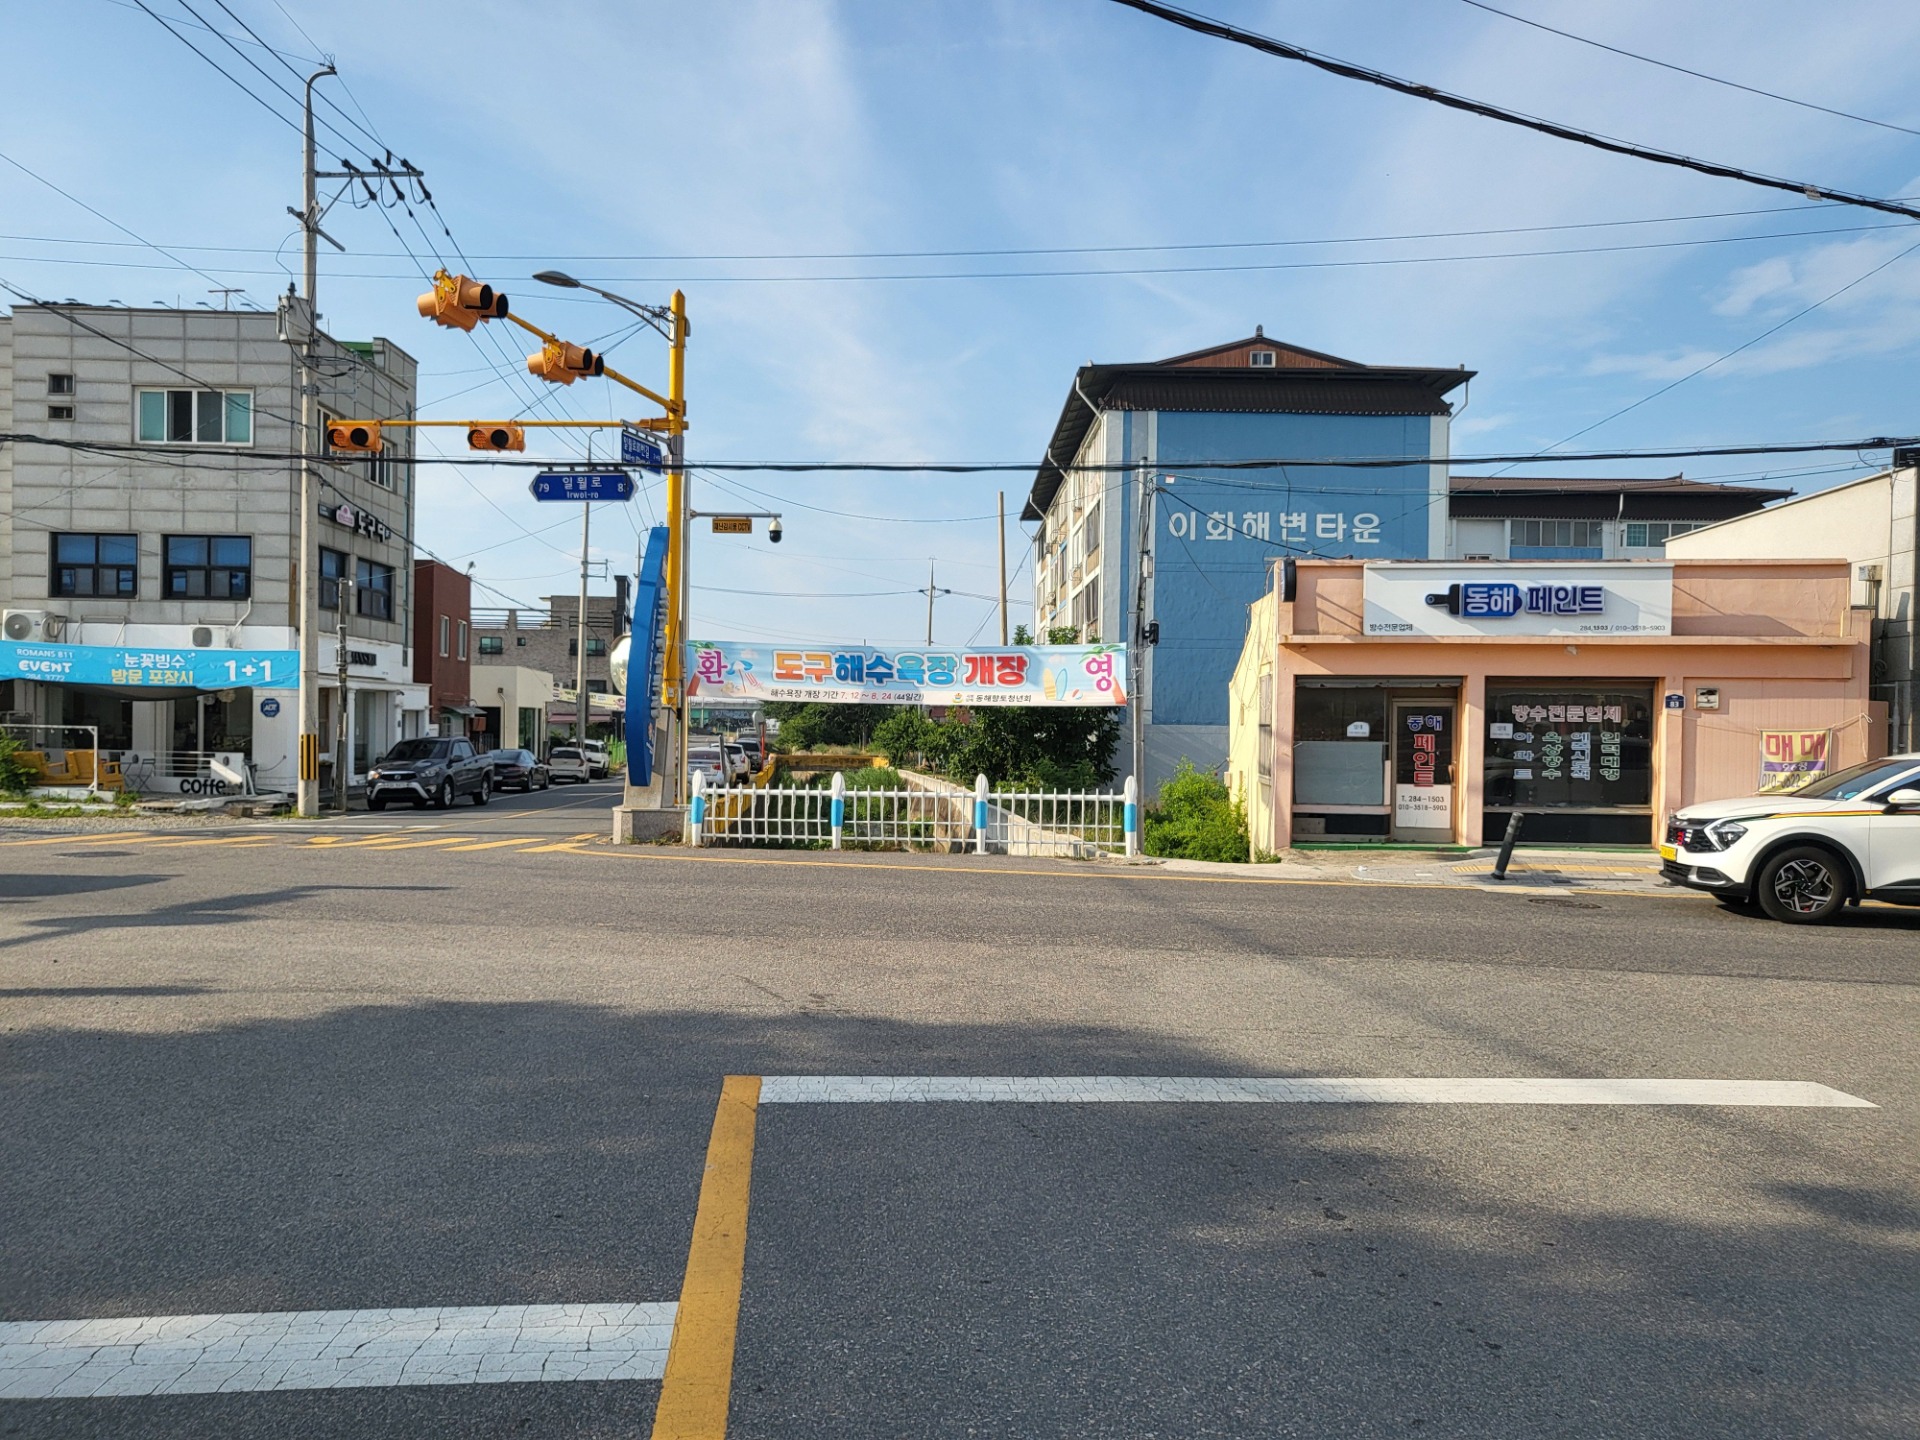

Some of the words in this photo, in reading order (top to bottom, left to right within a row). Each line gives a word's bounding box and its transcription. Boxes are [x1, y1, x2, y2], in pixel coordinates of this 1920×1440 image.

[539, 483, 550, 493] 79
[562, 476, 602, 490] 일월로
[566, 491, 599, 499] Irwol-ro
[1168, 511, 1382, 544] 이화해변타운
[1466, 586, 1515, 614] 동해
[1527, 585, 1604, 615] 페인트
[1369, 623, 1413, 632] 방수전문업체
[16, 648, 56, 658] ROMANS
[124, 653, 186, 669] 눈꽃빙수
[18, 659, 72, 673] EVENT
[224, 660, 272, 682] 1+1
[697, 650, 728, 684] 환
[774, 651, 958, 687] 도구해수욕장
[964, 654, 1028, 687] 개장
[1085, 653, 1113, 692] 영
[112, 669, 143, 684] 방문
[149, 670, 194, 685] 포장시
[770, 688, 802, 698] 해수욕장
[804, 690, 820, 699] 개장
[822, 690, 838, 699] 기간
[893, 692, 925, 702] (44일간)
[1511, 704, 1622, 723] 방수전문업체
[1407, 715, 1443, 731] 동해
[1413, 734, 1435, 787] 페인트
[1512, 731, 1535, 780] 아파트
[1541, 731, 1564, 780] 옥상방수
[1570, 731, 1591, 781] 에폭시도색
[1408, 795, 1445, 803] 284-1503
